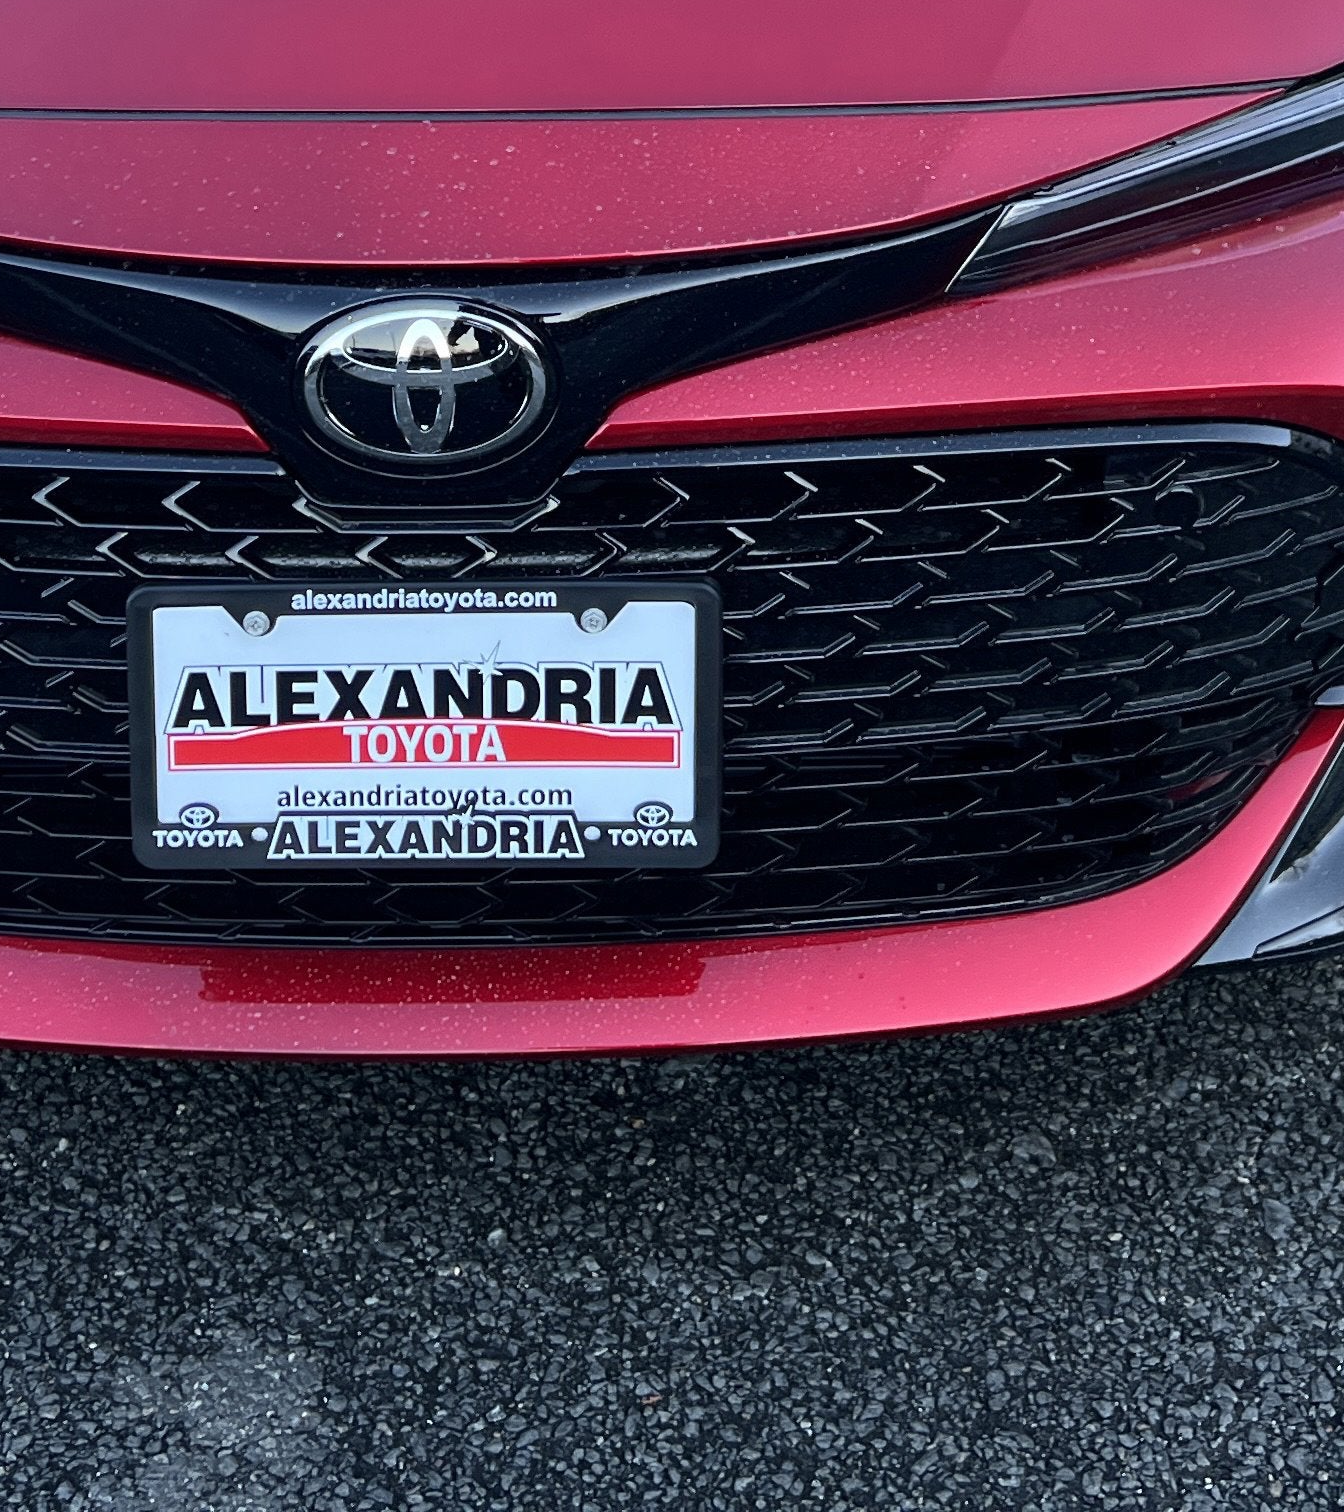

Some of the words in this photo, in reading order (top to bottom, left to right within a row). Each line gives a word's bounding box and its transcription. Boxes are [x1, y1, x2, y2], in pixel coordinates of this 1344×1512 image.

[291, 588, 557, 613] alexandriatoyota.com
[170, 666, 676, 729] ALEXANDRIA
[342, 723, 507, 763] TOYOTA
[276, 784, 573, 808] alexandriatoyota.com
[152, 829, 244, 848] TOYOTA
[269, 818, 583, 857] ALEXANDRIA
[607, 828, 698, 847] TOYOTA
